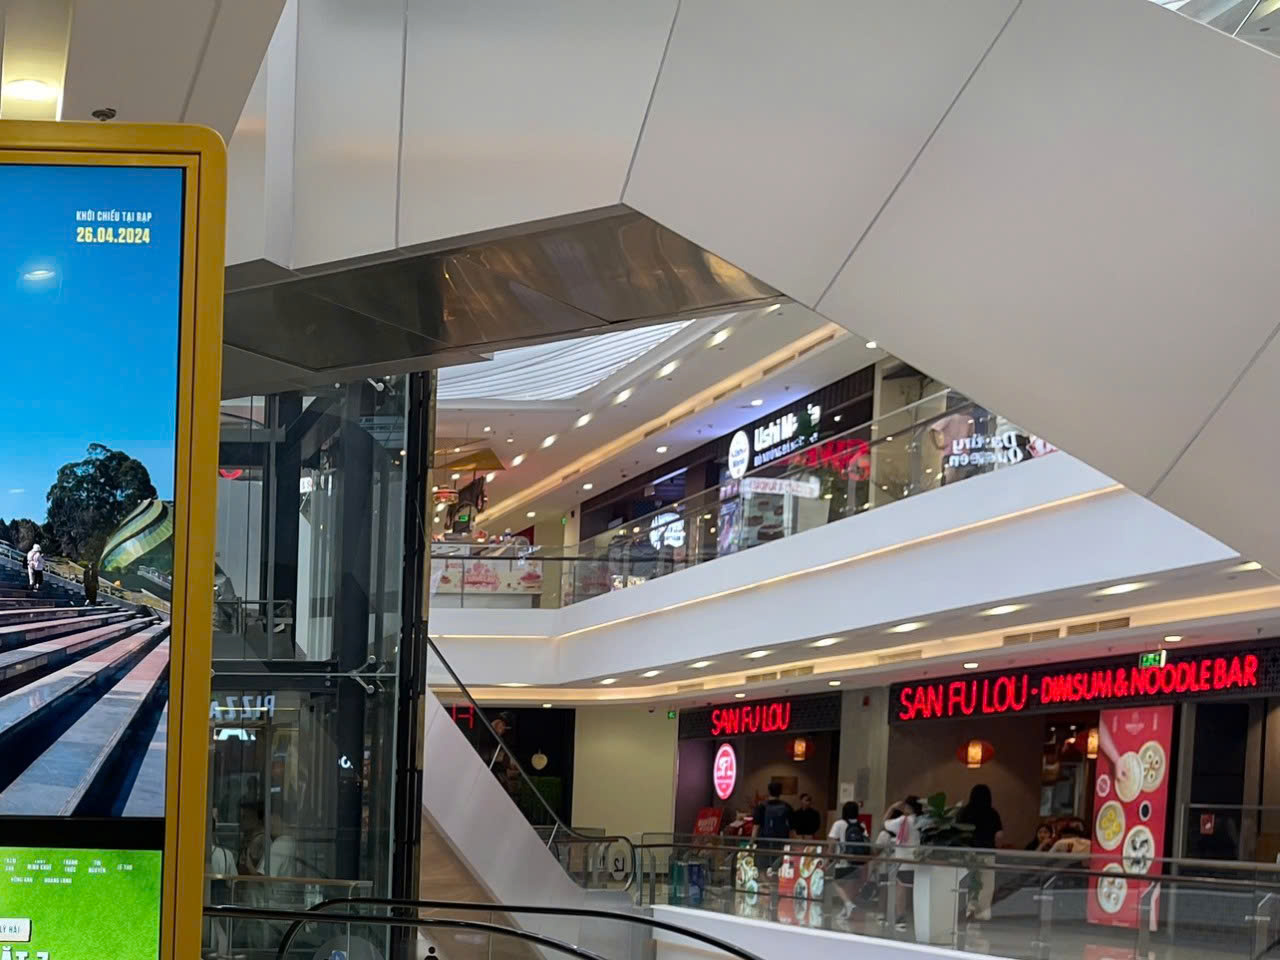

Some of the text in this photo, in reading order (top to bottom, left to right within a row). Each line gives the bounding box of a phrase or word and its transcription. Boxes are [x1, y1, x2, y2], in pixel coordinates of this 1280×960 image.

[76, 226, 151, 243] 26.04.2024
[898, 685, 943, 721] SAN
[946, 680, 977, 717] FU
[982, 674, 1028, 714] LOU
[1114, 668, 1128, 697] &
[1130, 659, 1211, 695] NOODLE
[1213, 654, 1259, 690] BAR
[711, 702, 791, 735] SAN FU LOU
